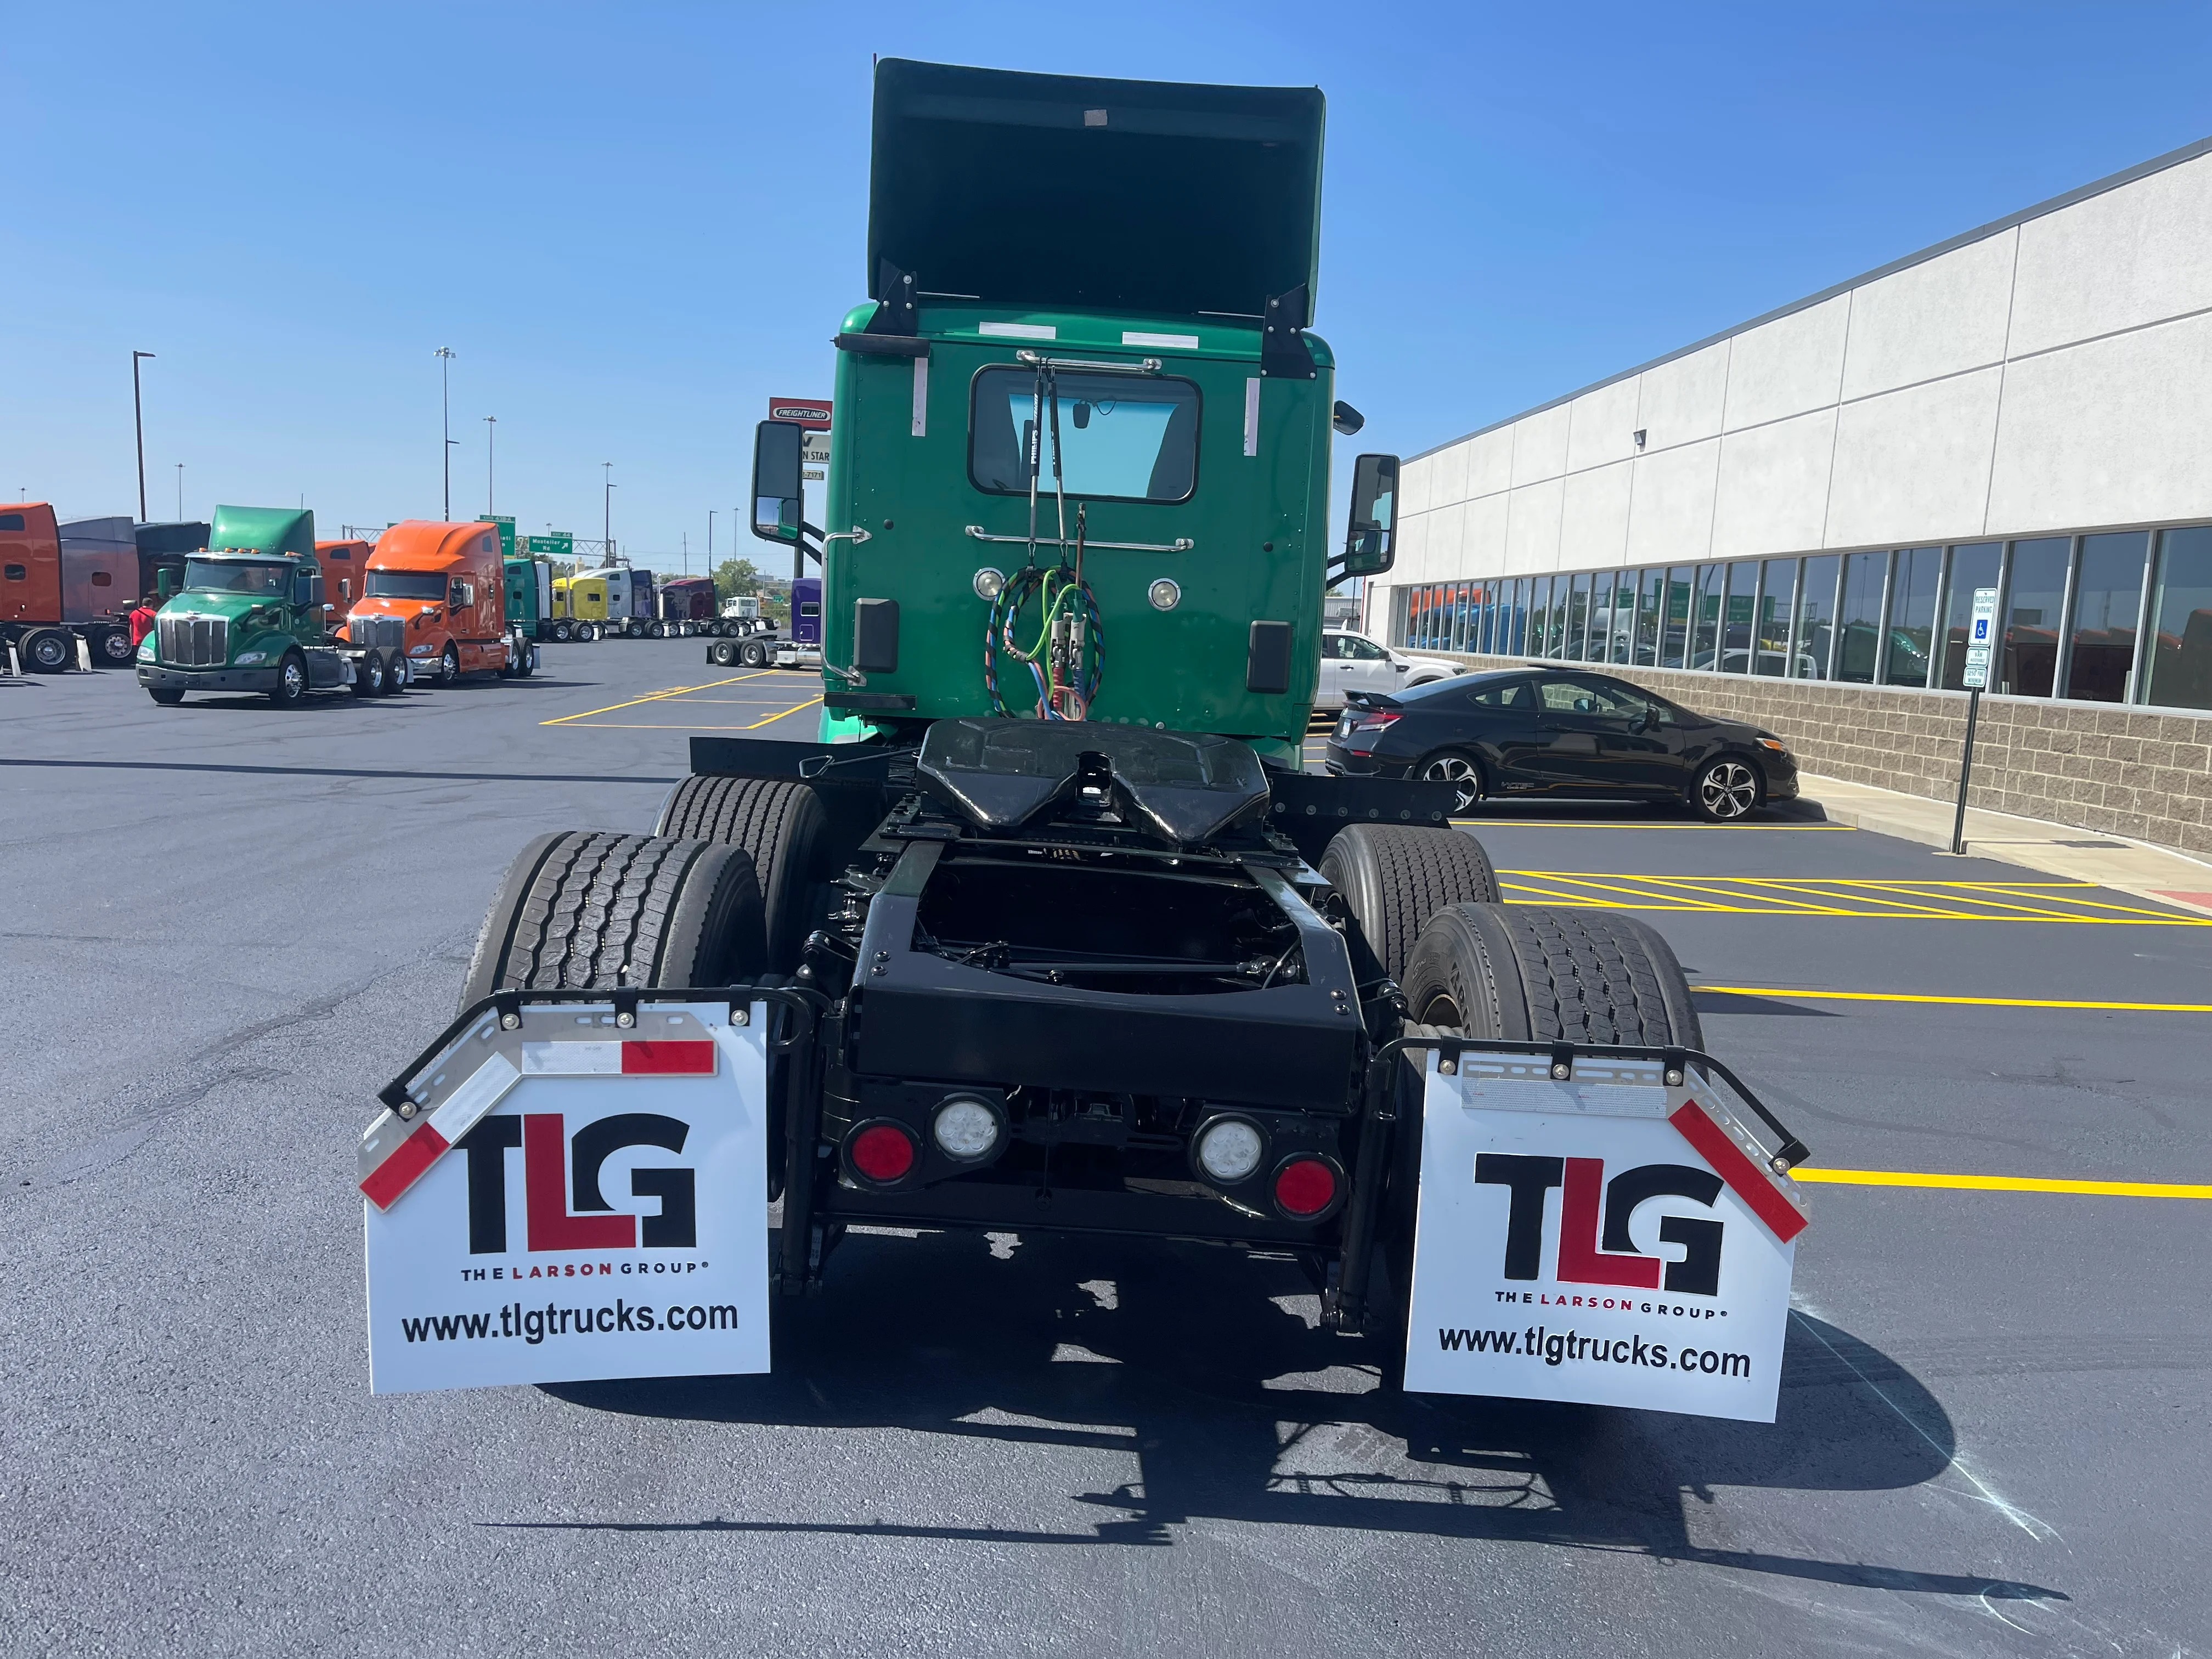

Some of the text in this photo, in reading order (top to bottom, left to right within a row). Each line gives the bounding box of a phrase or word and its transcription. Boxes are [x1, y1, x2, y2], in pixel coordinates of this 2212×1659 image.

[778, 409, 826, 419] FREIGHTLINER
[811, 451, 830, 461] STAR
[450, 1113, 697, 1255] TLG
[1474, 1152, 1725, 1296] TLG
[461, 1268, 504, 1282] THE
[512, 1263, 612, 1280] LARSON
[1495, 1291, 1533, 1304] THE
[1540, 1293, 1633, 1311] LARSON
[401, 1299, 738, 1345] www.tlgtrucks.com
[1438, 1326, 1751, 1378] www.tlgtrucks.com
